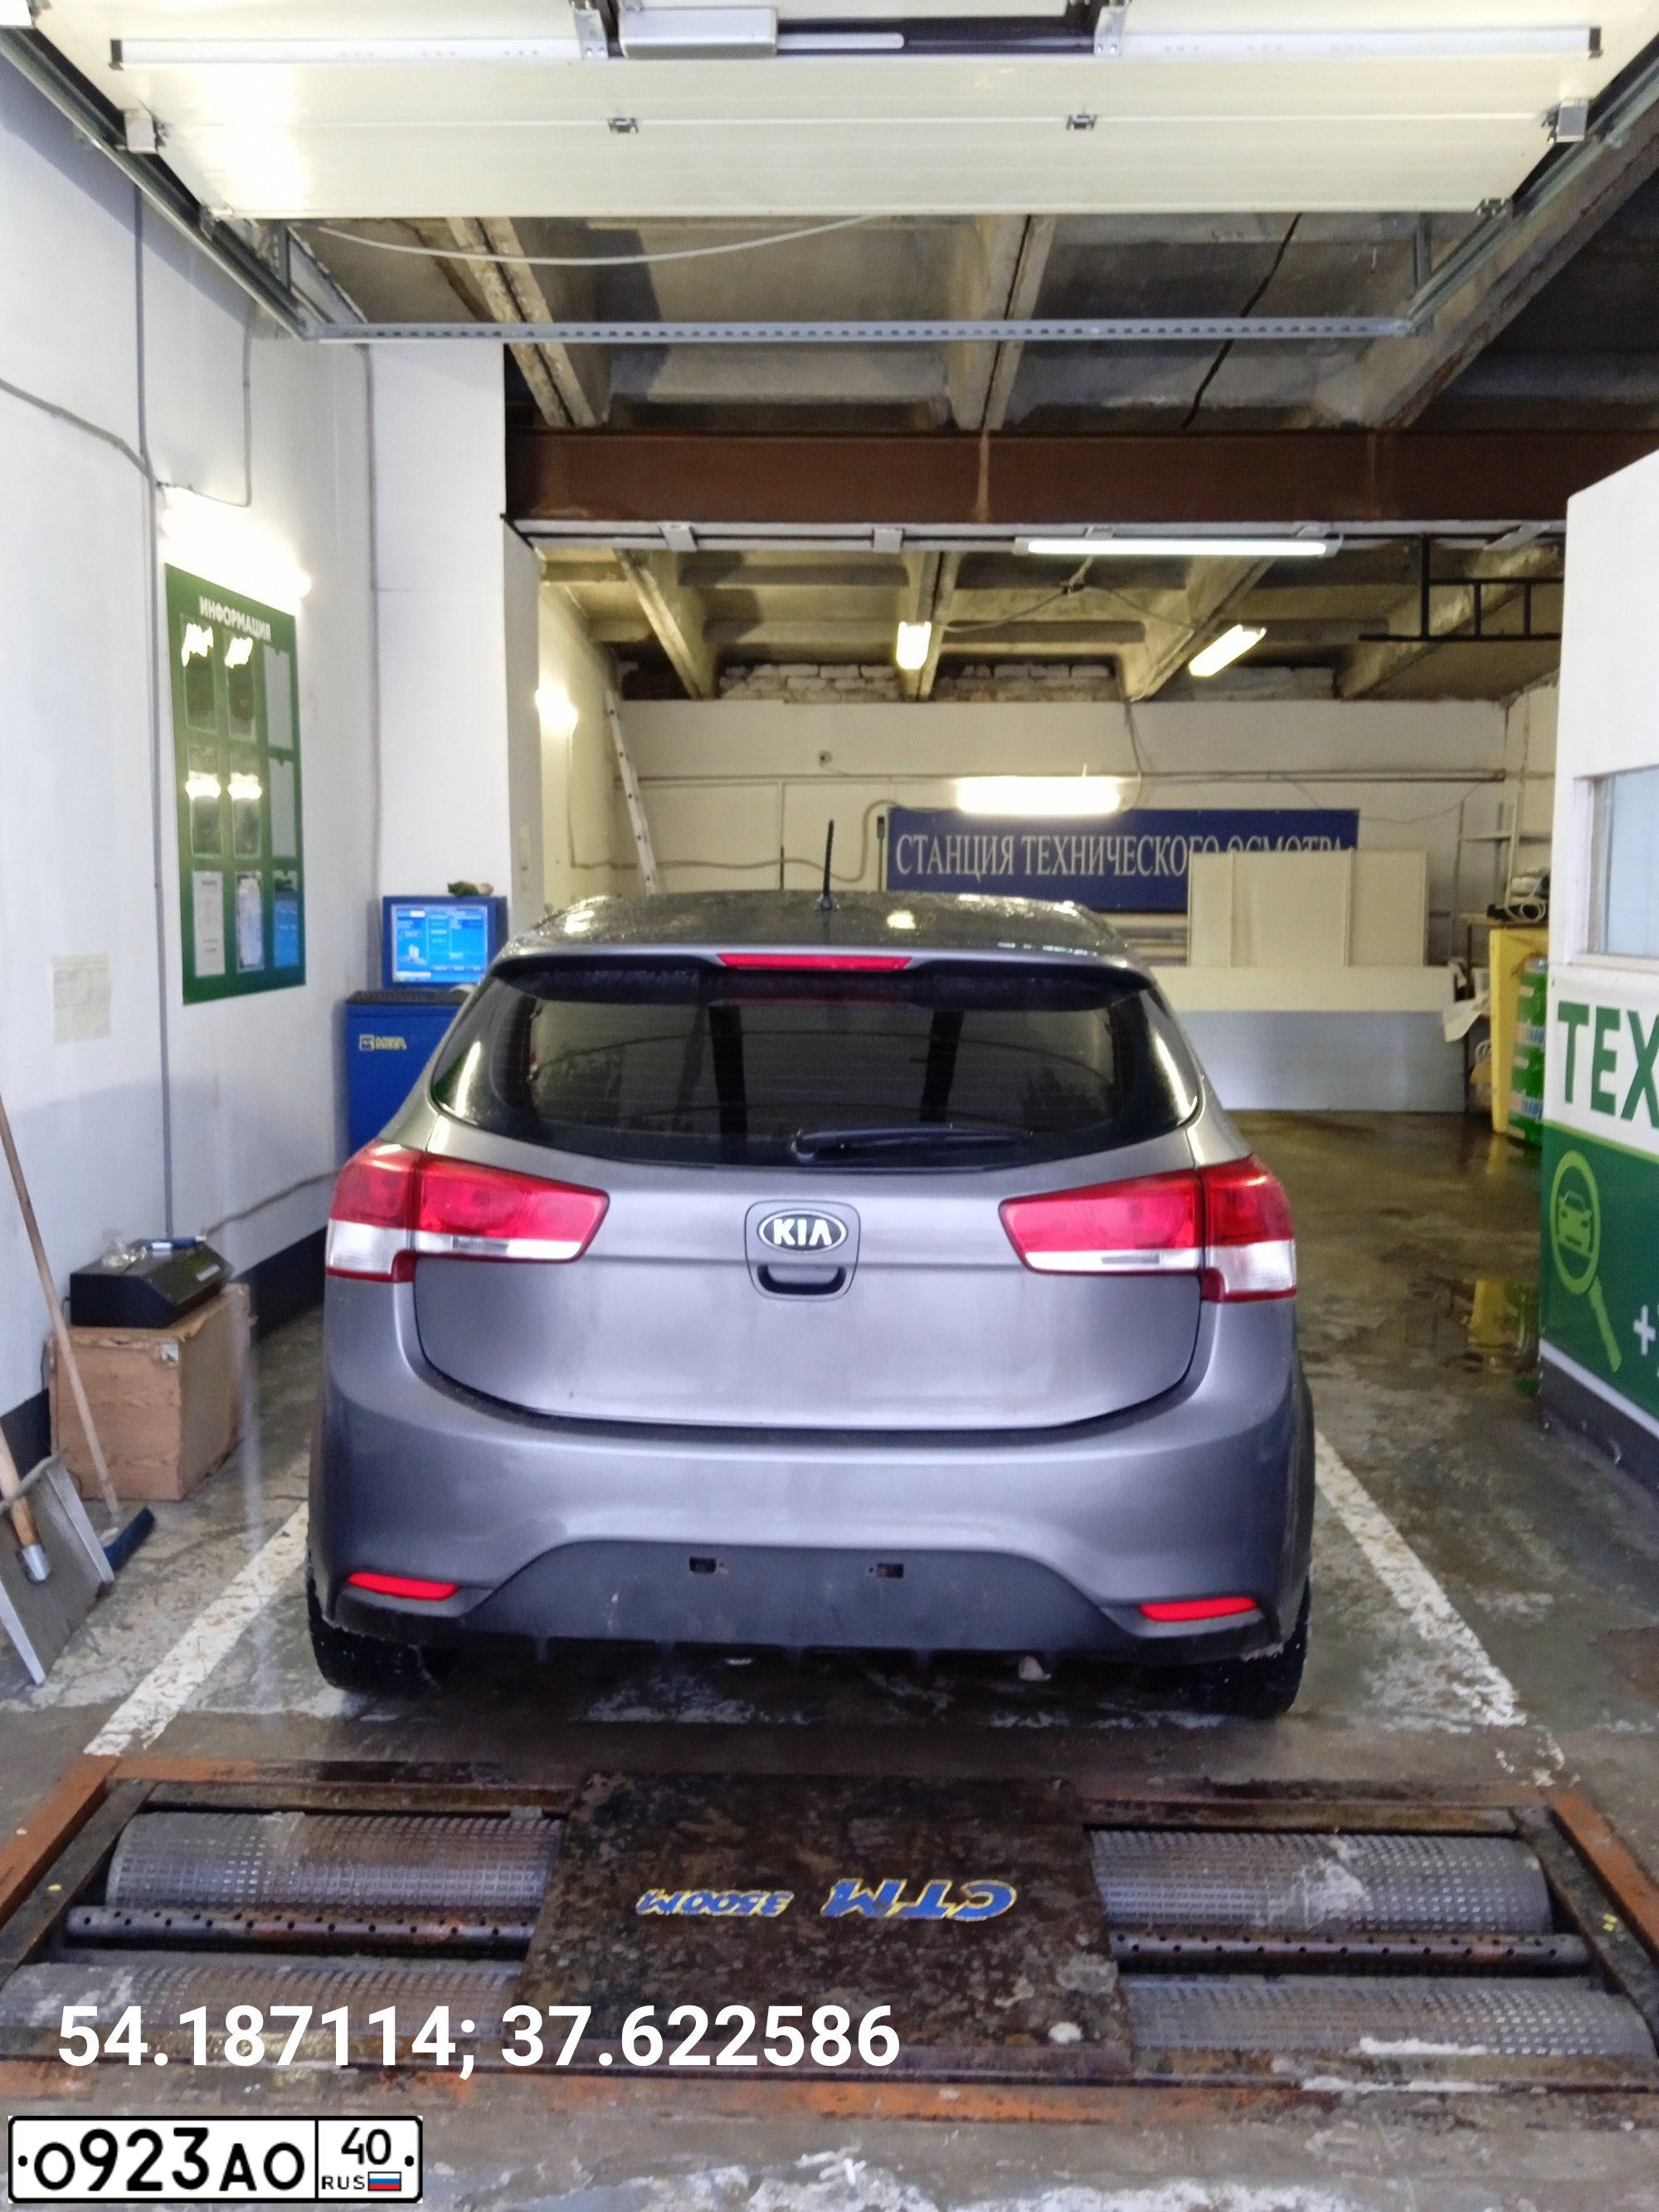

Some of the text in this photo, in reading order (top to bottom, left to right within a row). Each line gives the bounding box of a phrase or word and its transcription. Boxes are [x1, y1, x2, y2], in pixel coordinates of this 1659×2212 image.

[198, 596, 272, 642] ИНФОРМАЦИЯ
[896, 833, 1014, 881] СТАНЦИЯ
[773, 1218, 832, 1246] KIA
